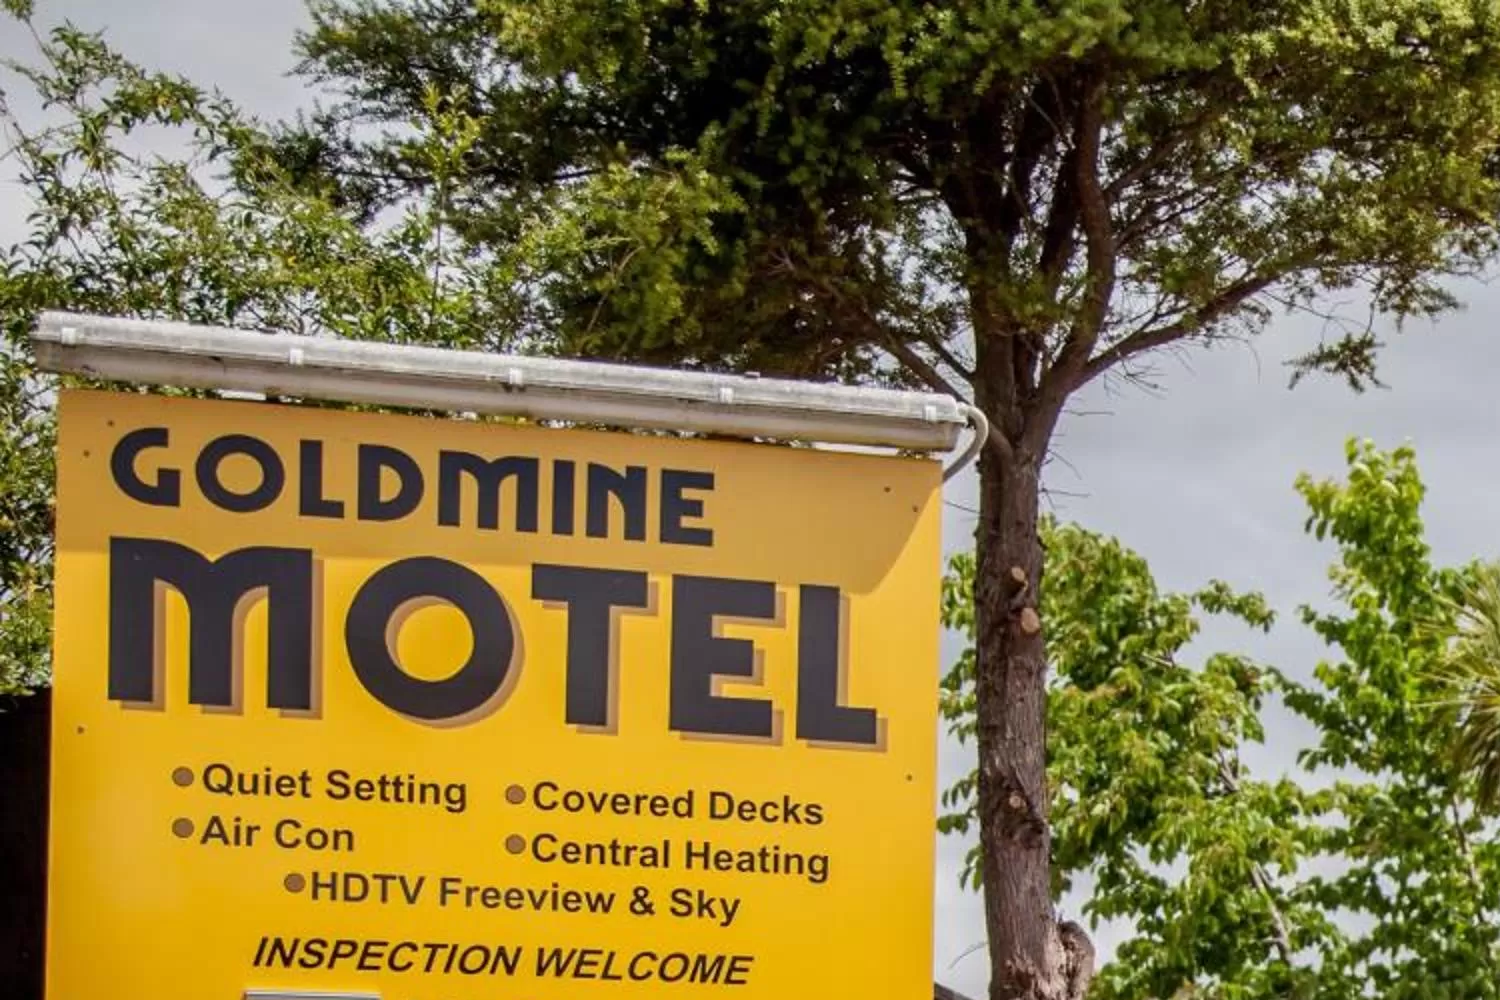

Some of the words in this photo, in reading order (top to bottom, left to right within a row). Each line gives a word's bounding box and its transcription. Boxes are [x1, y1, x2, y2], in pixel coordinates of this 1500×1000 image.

[109, 426, 716, 547] GOLDMINE
[107, 535, 886, 751] MOTEL
[202, 762, 312, 798] Quiet
[325, 769, 468, 813] Setting
[532, 780, 694, 819] Covered
[709, 790, 825, 826] Decks
[200, 814, 262, 847] Air
[274, 818, 355, 852] Con
[531, 832, 671, 869] Central
[685, 840, 830, 884] Heating
[311, 871, 425, 906] HDTV
[439, 877, 616, 914] Freeview
[628, 885, 656, 916] &
[669, 887, 741, 927] Sky
[252, 936, 523, 977] INSPECTION
[534, 946, 755, 986] WELCOME
